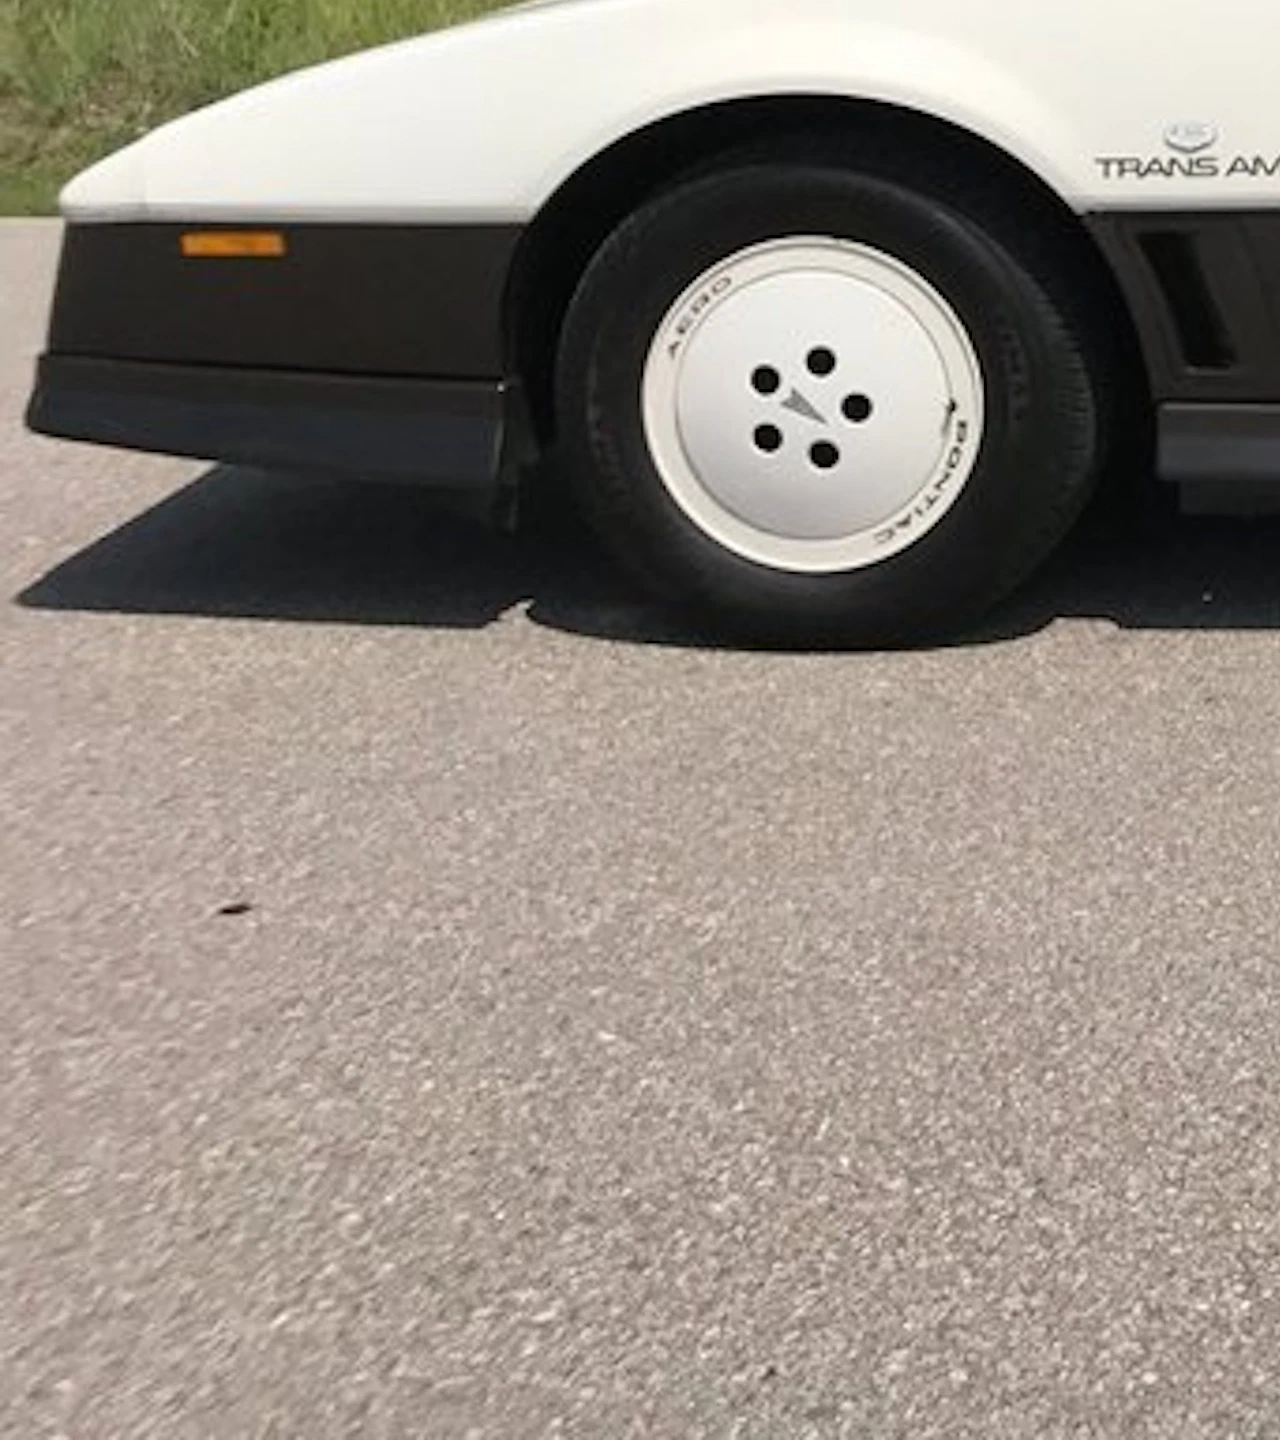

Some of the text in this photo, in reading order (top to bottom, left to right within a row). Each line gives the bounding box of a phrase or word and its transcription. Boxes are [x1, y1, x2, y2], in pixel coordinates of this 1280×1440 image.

[1096, 157, 1219, 179] TRANS
[668, 277, 732, 358] AERO
[874, 421, 967, 545] PONTIAC
